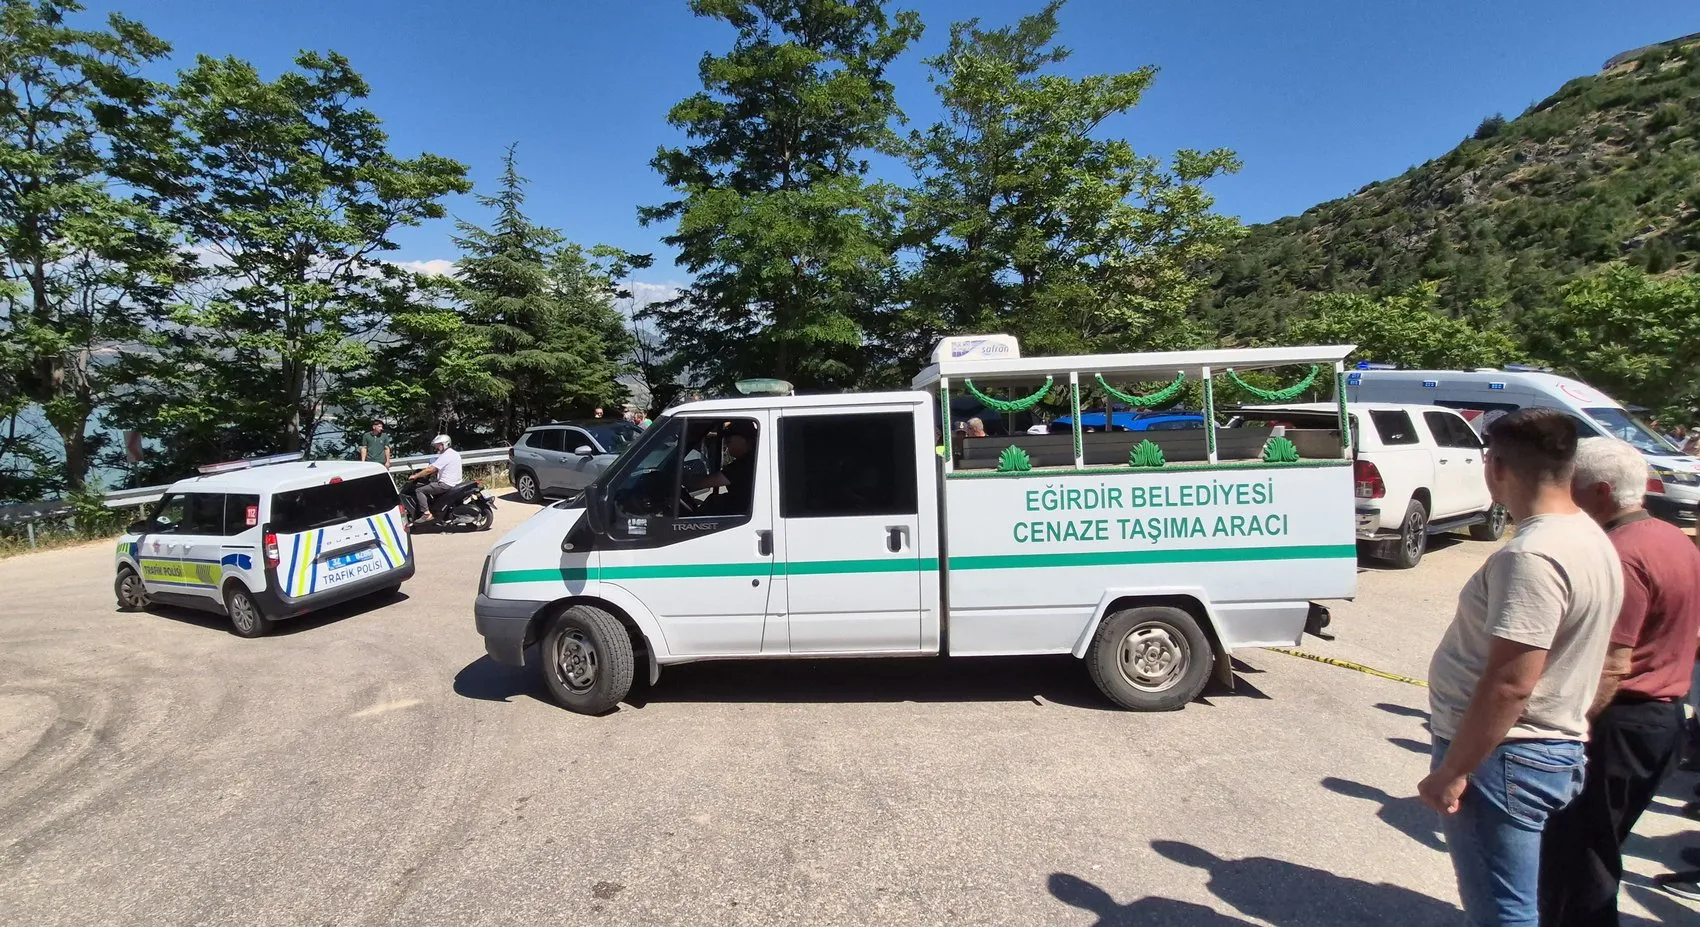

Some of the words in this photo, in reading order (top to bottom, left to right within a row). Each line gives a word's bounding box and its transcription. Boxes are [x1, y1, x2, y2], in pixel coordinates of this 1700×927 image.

[1025, 483, 1124, 512] EĞİRDİR
[1131, 477, 1274, 508] BELEDİYESİ
[672, 522, 719, 531] TRANSIT
[1013, 519, 1110, 543] CENAZE
[1117, 516, 1207, 545] TAŞIMA
[1212, 513, 1288, 538] ARACI
[323, 566, 355, 585] TRAFİK
[357, 559, 383, 576] POLİSİ
